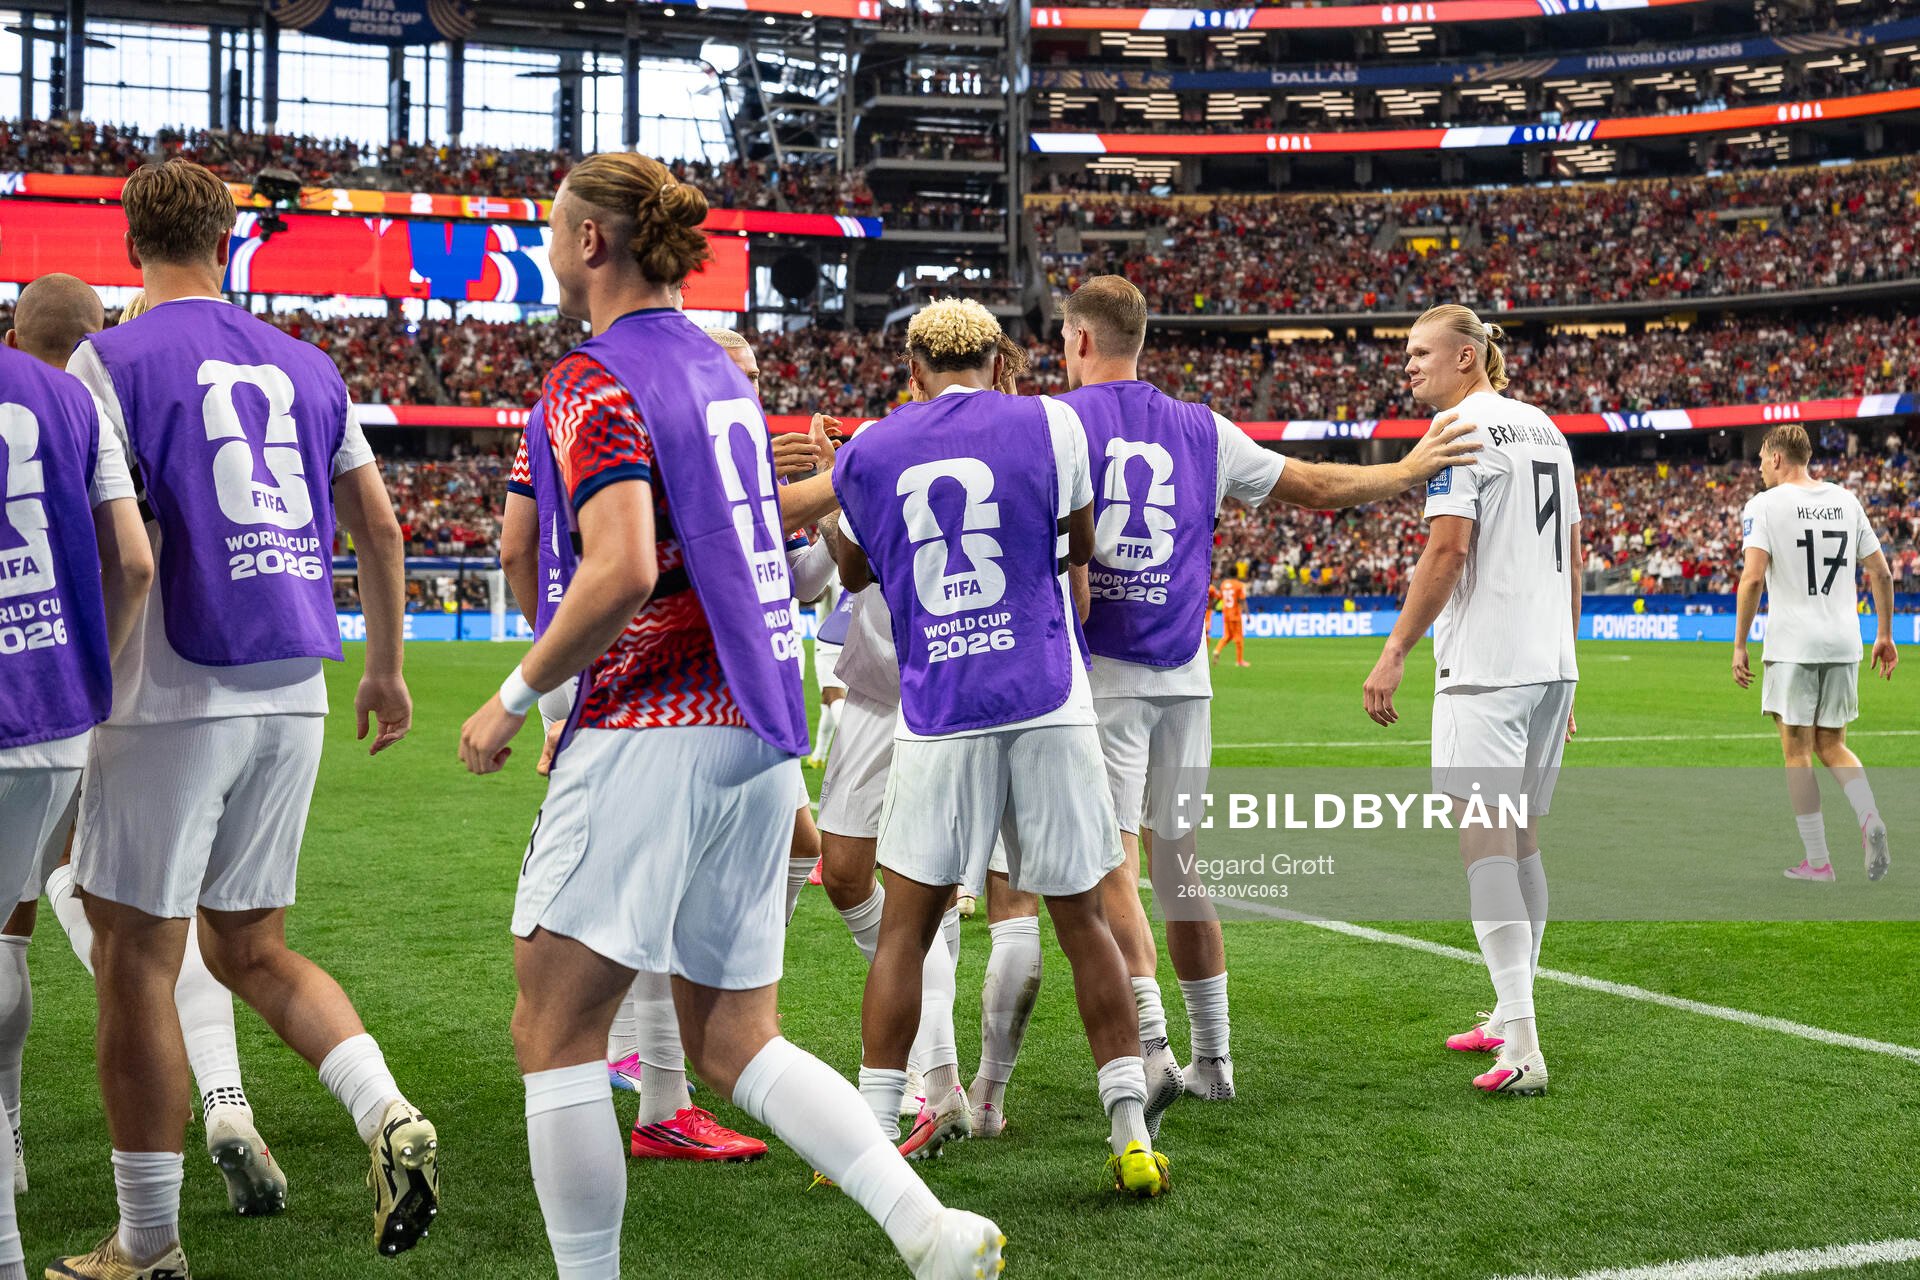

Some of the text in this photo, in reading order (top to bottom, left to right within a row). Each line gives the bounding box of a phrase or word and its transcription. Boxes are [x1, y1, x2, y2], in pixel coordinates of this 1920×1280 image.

[334, 6, 422, 25] WORLD CUP
[1036, 10, 1062, 26] AL
[1586, 42, 1743, 70] FIFA WORLD CUP 2026
[1271, 71, 1358, 84] DALLAS
[1777, 102, 1823, 121] GOAL
[1266, 135, 1312, 150] GOAL
[410, 193, 433, 213] 2
[252, 490, 289, 514] FIFA
[1797, 506, 1844, 520] HEGGEM
[1531, 460, 1562, 573] 9
[225, 531, 320, 553] WORLD CUP
[1116, 543, 1154, 559] FIFA
[0, 556, 40, 580] IFA
[229, 549, 323, 580] 2026
[756, 561, 784, 584] FIFA
[1797, 529, 1848, 596] 17
[943, 579, 982, 600] FIFA
[1140, 572, 1171, 584] CUP
[1089, 585, 1168, 605] 2026
[0, 598, 61, 624] RLD CU
[763, 608, 789, 629] RLD
[923, 612, 1012, 639] WORLD CUP
[1242, 612, 1373, 637] POWERADE
[1592, 614, 1680, 640] POWERADE
[0, 618, 68, 655] 026
[770, 629, 799, 661] 02
[927, 628, 1016, 664] 2026
